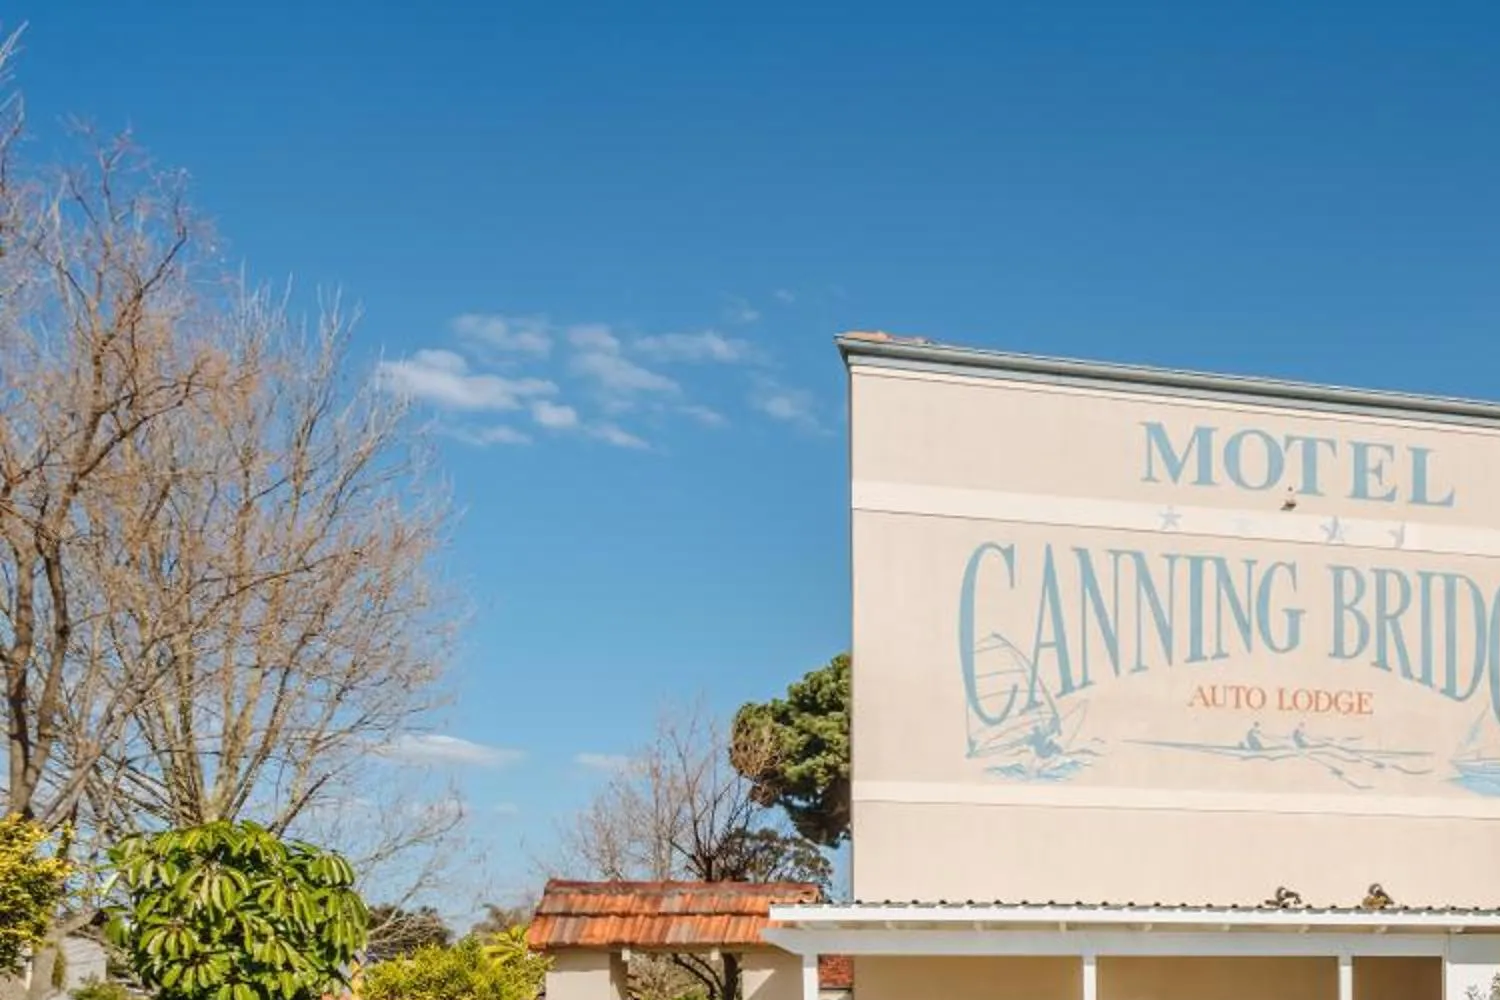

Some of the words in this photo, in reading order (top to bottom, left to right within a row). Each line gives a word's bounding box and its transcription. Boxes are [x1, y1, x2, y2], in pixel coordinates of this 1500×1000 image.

[1139, 420, 1456, 509] MOTEL
[958, 541, 1307, 727] CANNING
[1187, 685, 1267, 712] AUTO
[1276, 687, 1375, 716] LODGE
